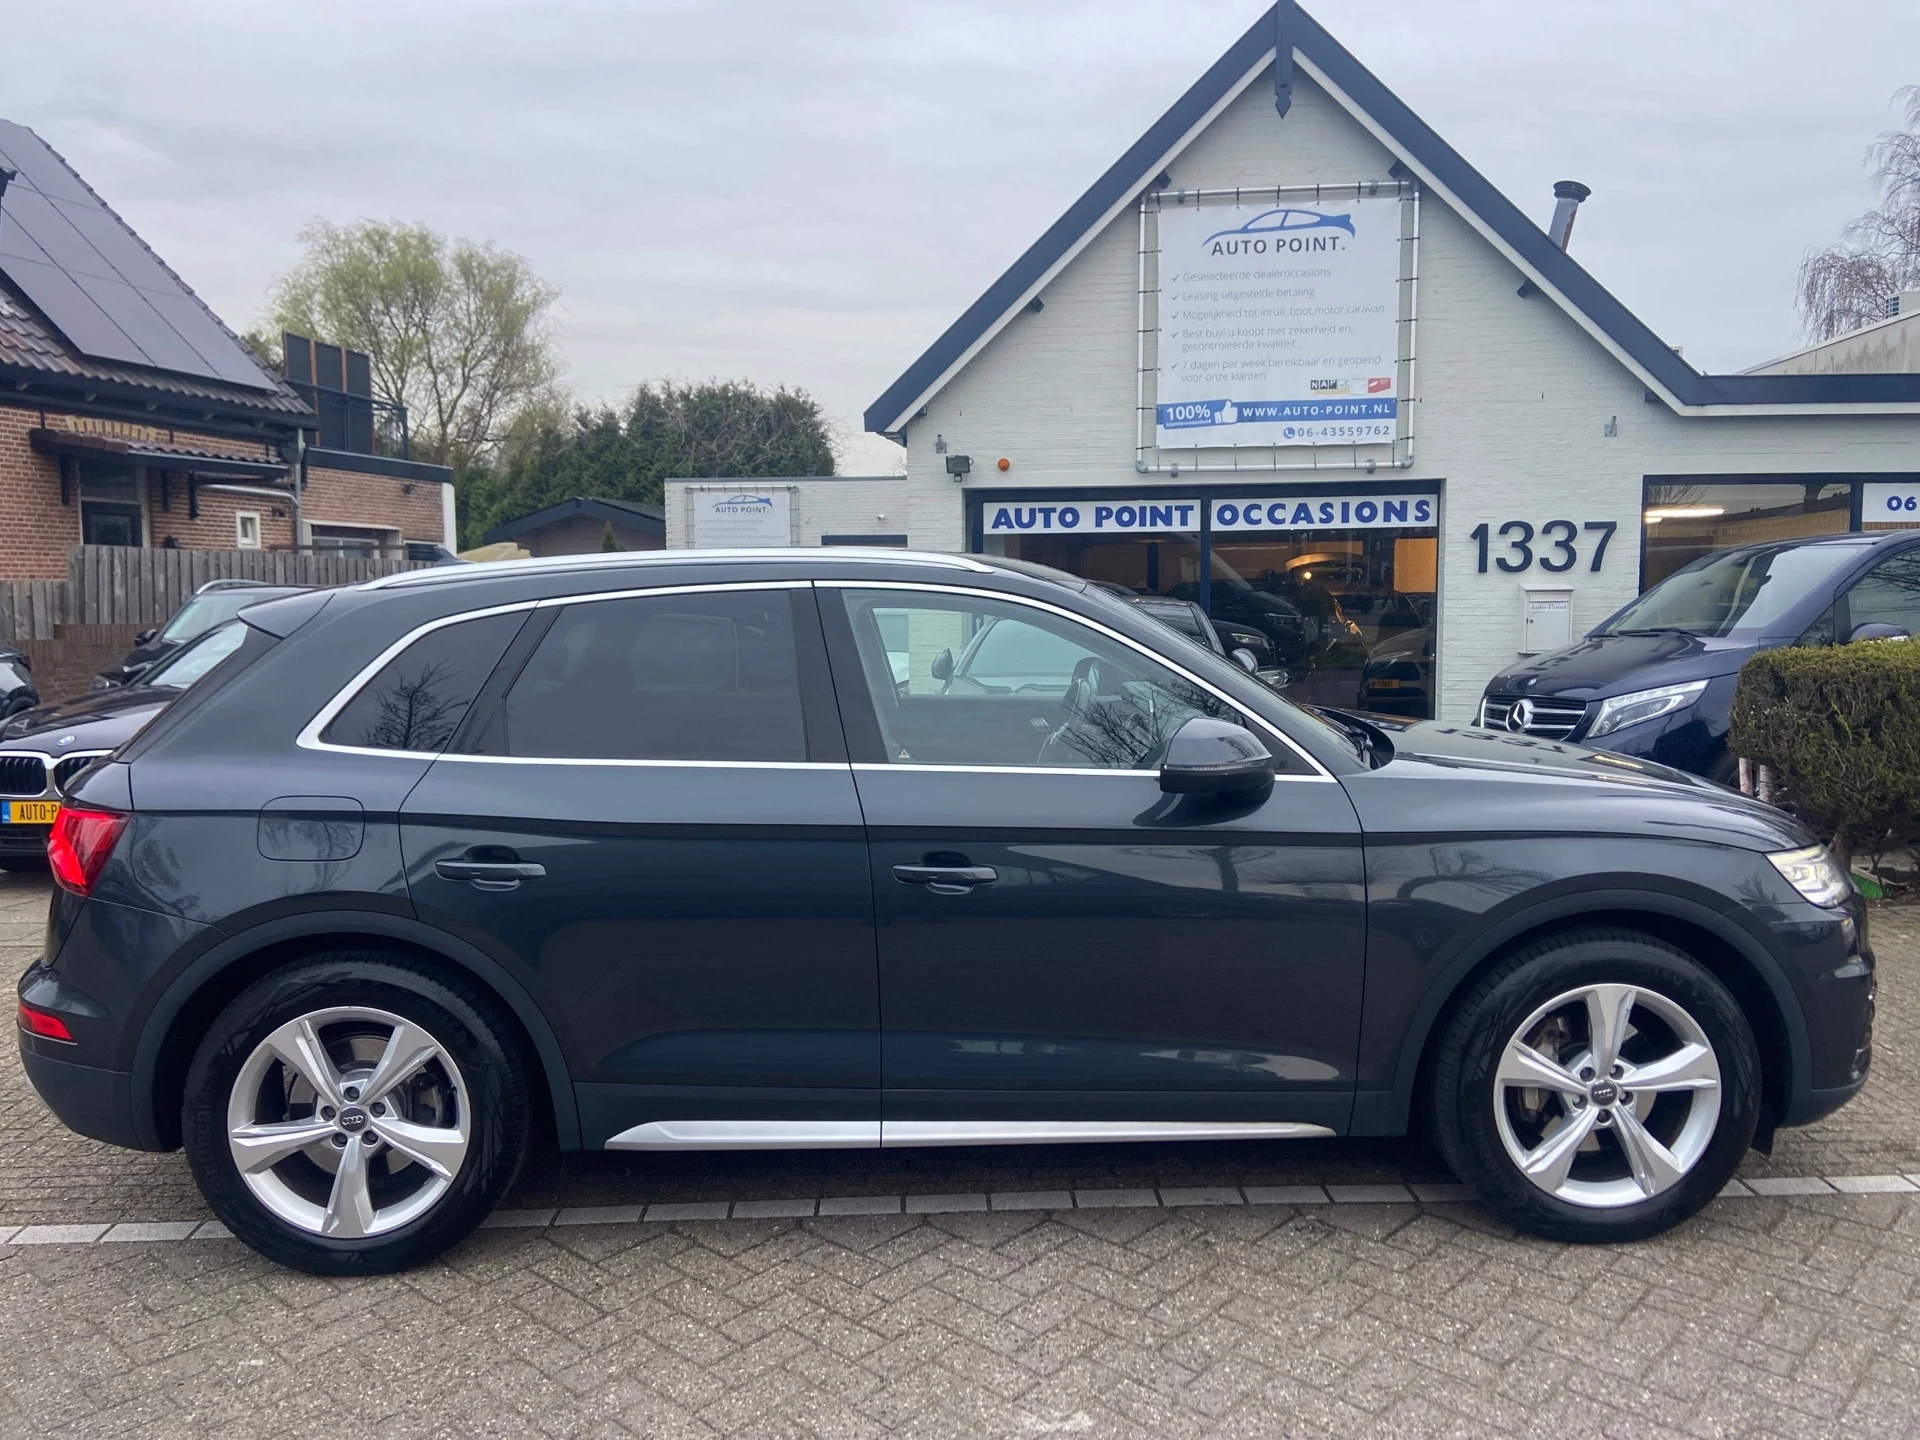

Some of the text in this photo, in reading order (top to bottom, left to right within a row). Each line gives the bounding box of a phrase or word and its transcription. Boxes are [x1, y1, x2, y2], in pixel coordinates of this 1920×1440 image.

[1212, 236, 1346, 255] AUTO POINT.
[1183, 268, 1332, 282] Geselecteerde dealeroccasions
[1276, 287, 1315, 299] betaling
[1183, 309, 1242, 321] Mogelijkheid
[1244, 309, 1258, 317] tot
[1182, 329, 1202, 338] Best
[1206, 329, 1225, 340] buy!
[1238, 327, 1264, 339] koopt
[1267, 328, 1286, 336] met
[1289, 325, 1336, 335] zekerheid
[1182, 339, 1296, 353] gecontroleerde kwaliteit
[1182, 355, 1381, 372] 7 dagen per week bereikbaar en geopend
[1182, 372, 1266, 382] voor onze klanten
[1311, 380, 1337, 390] NAP
[1166, 404, 1211, 420] 100%
[1243, 404, 1391, 417] WWW.AUTO-POINT.NL
[1298, 425, 1390, 437] 06-43559762
[1887, 496, 1918, 511] 06
[991, 505, 1194, 529] AUTO POINT
[1216, 500, 1431, 526] OCCASIONS
[1470, 520, 1617, 574] 1337
